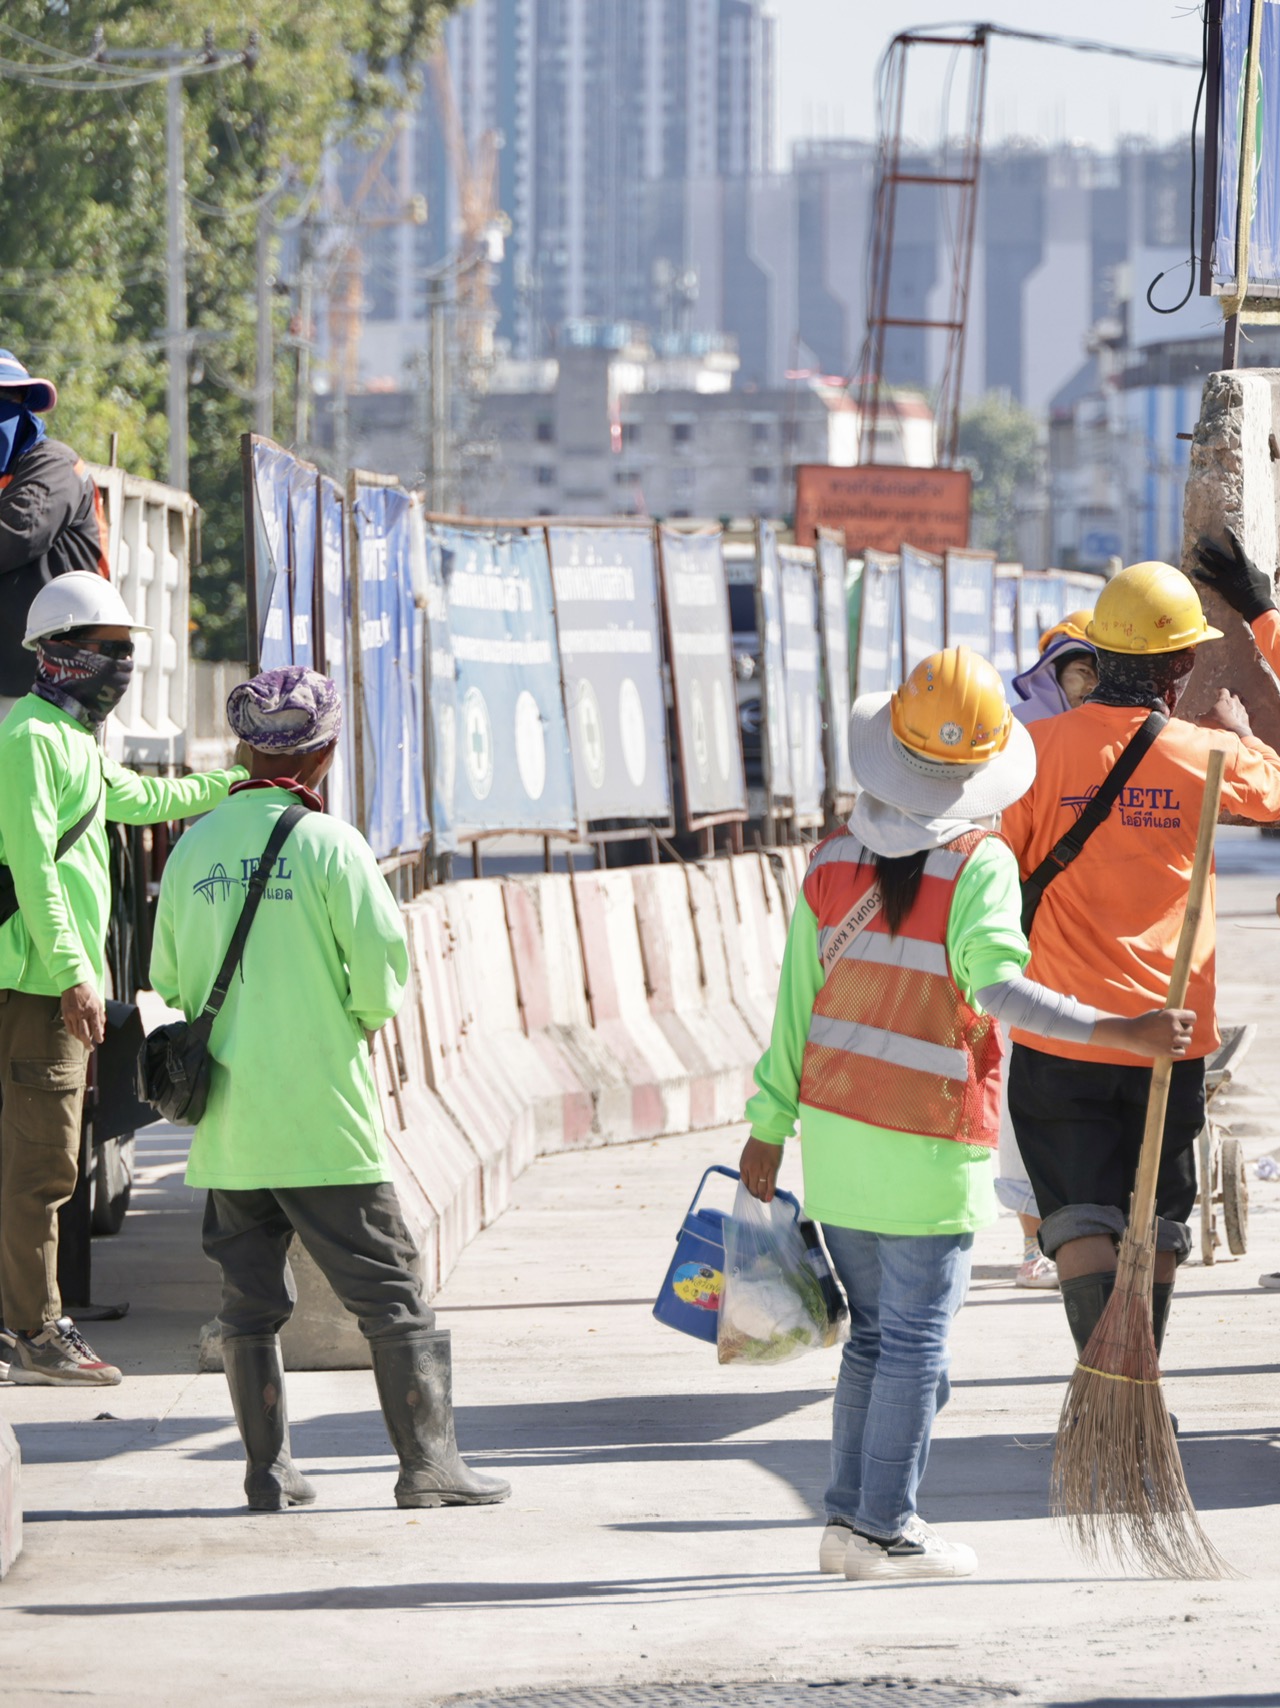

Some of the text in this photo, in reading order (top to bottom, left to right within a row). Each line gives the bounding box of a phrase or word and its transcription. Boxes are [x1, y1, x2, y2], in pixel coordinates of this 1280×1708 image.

[1119, 807, 1181, 829] ไออีทีแอล
[240, 857, 292, 881] IEL
[826, 891, 882, 965] COUPLE KAPOK
